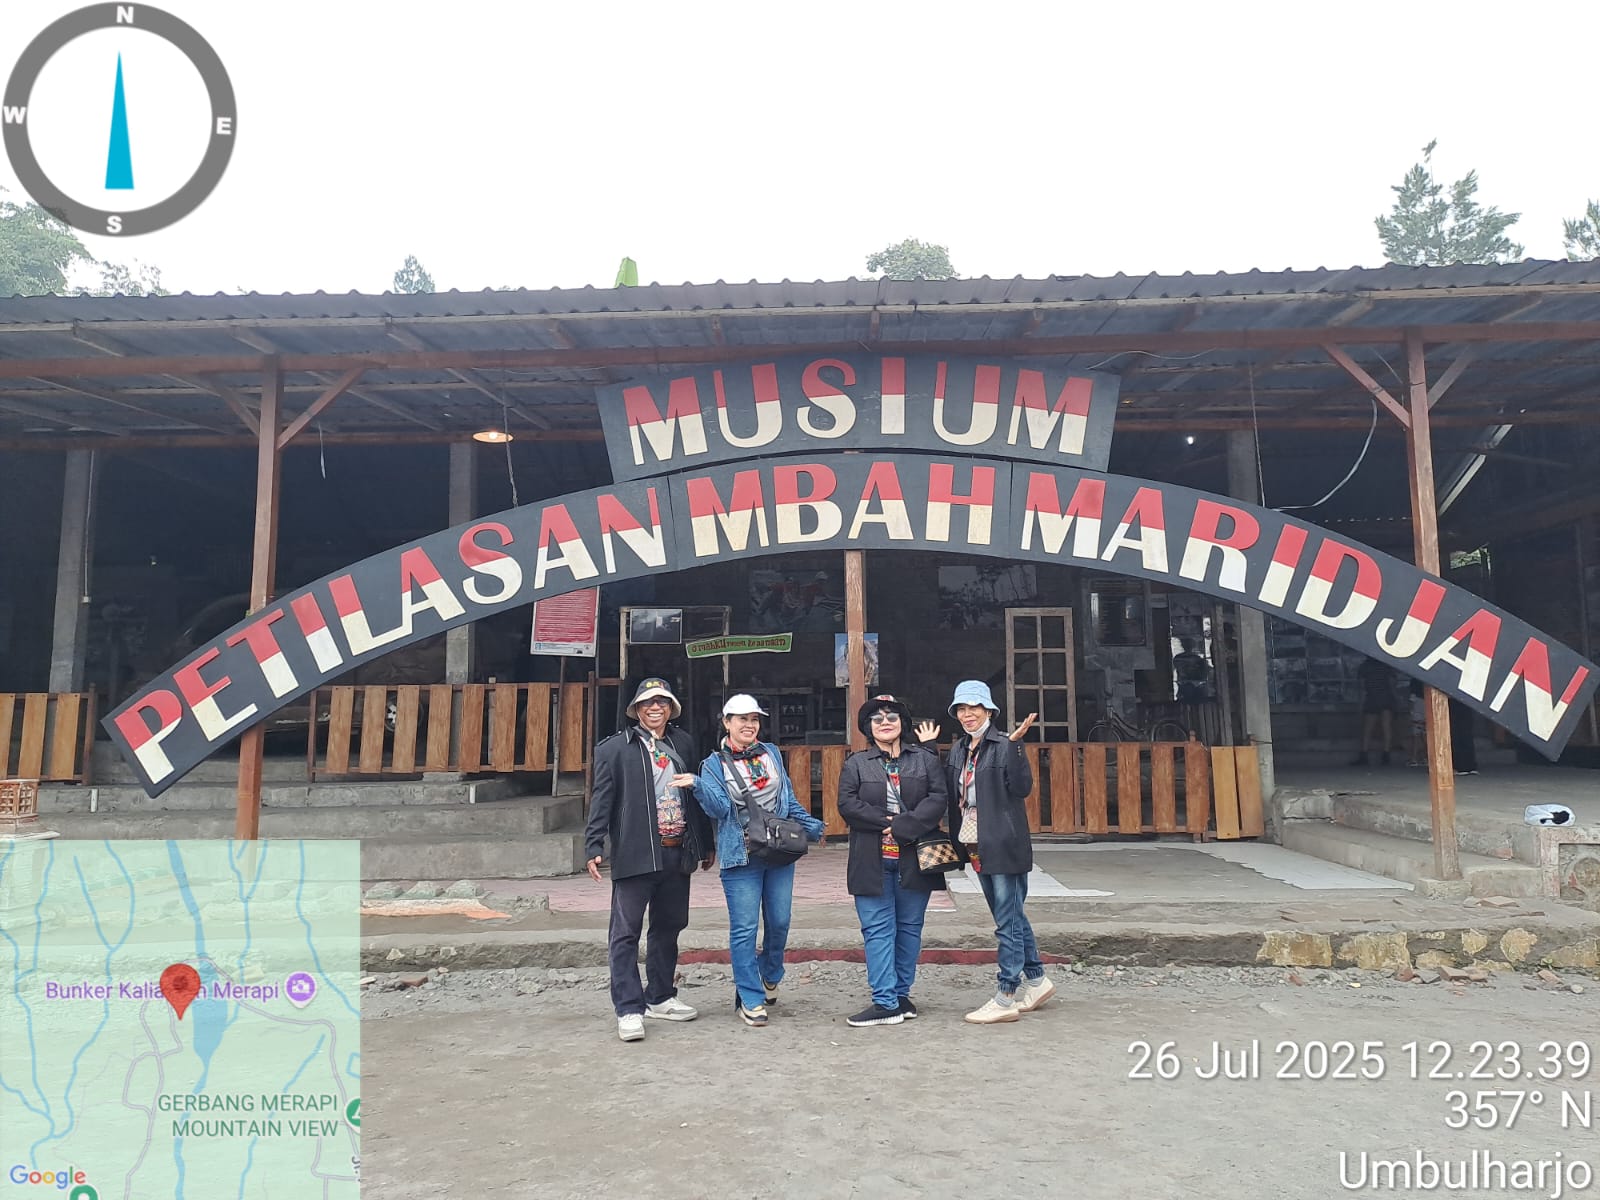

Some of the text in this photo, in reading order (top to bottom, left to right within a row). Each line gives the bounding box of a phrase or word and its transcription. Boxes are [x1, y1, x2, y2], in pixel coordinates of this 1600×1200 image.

[621, 357, 1094, 466] MUSIUM
[113, 461, 1590, 786] PETILASAN MBAH MARIDJAN
